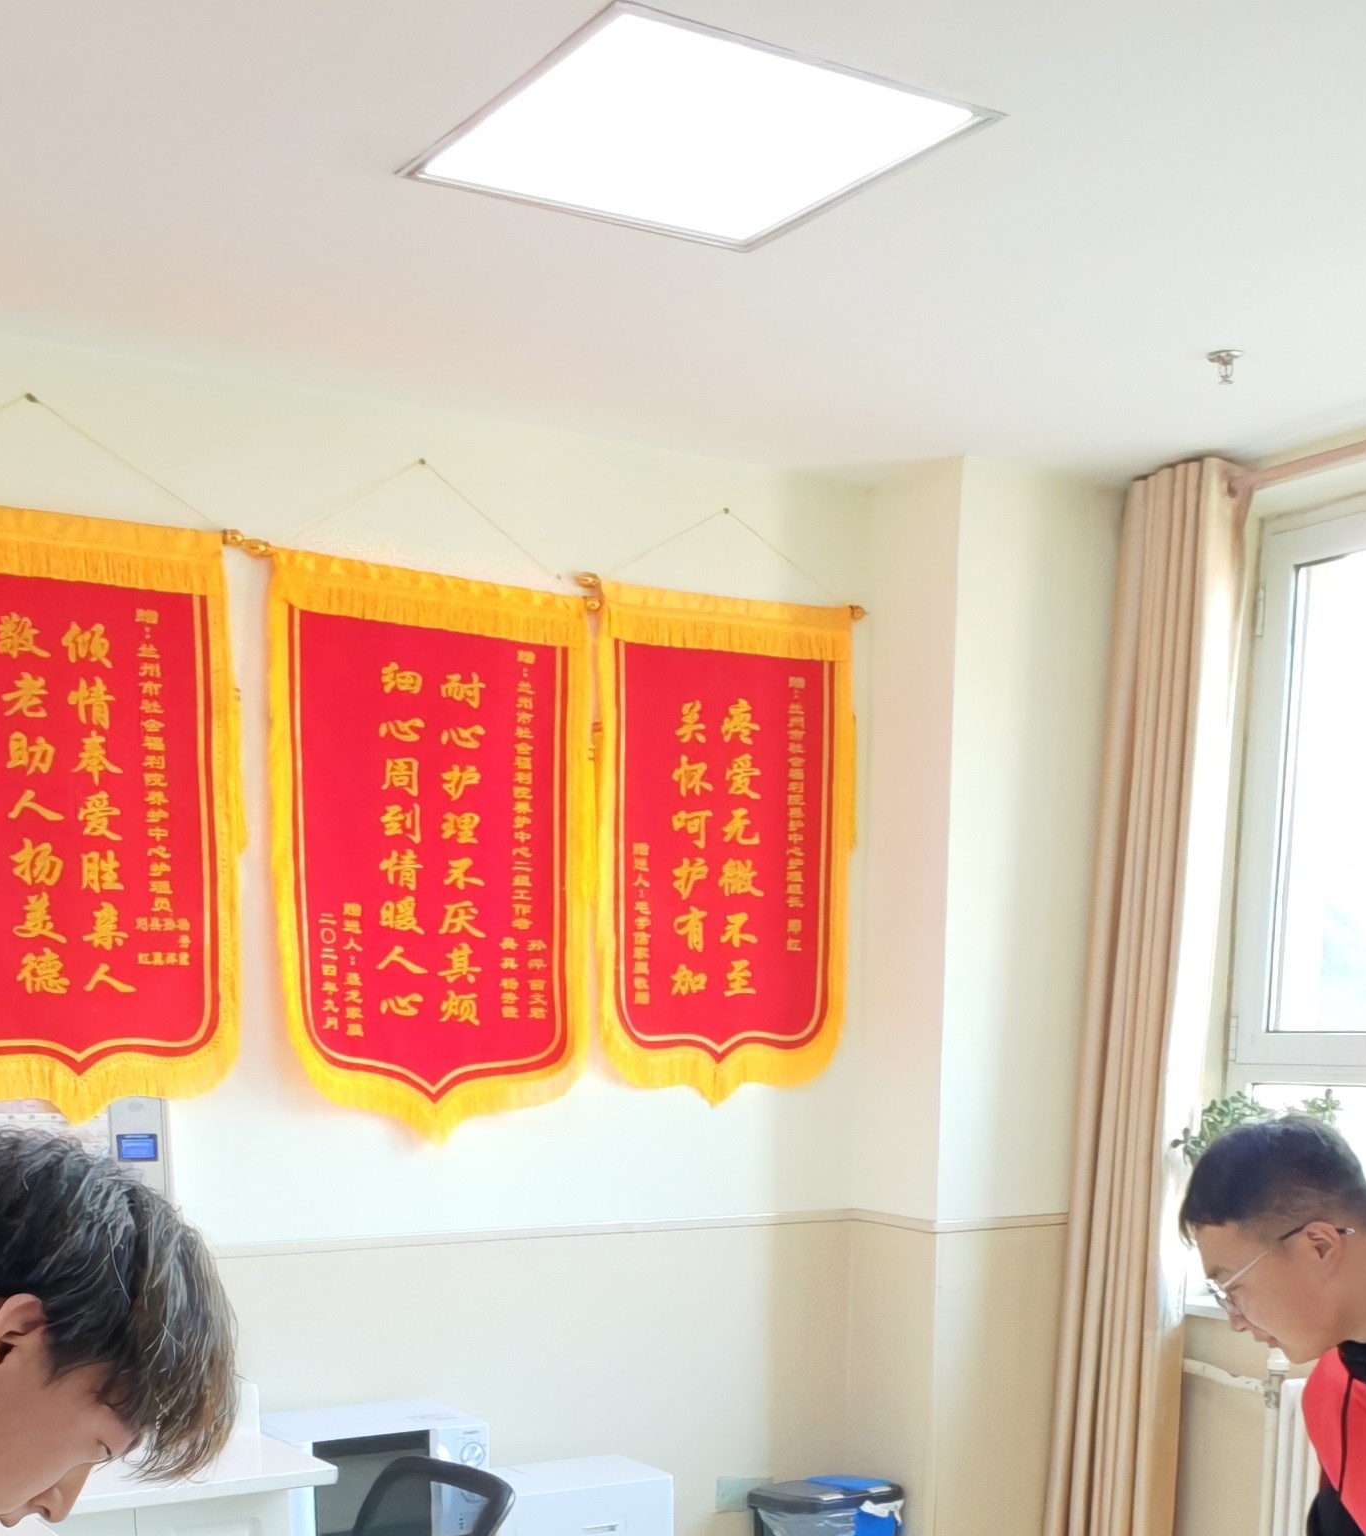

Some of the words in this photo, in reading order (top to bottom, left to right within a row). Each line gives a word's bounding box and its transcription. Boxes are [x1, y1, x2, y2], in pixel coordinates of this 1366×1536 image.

[61, 620, 137, 994] 倾情奉爱胜亲人
[376, 661, 429, 1017] 细心周到情暖人心
[438, 672, 487, 1027] 耐心护理不厌其烦
[670, 700, 714, 997] 关怀呵护有加
[718, 698, 765, 998] 疼爱无微不至
